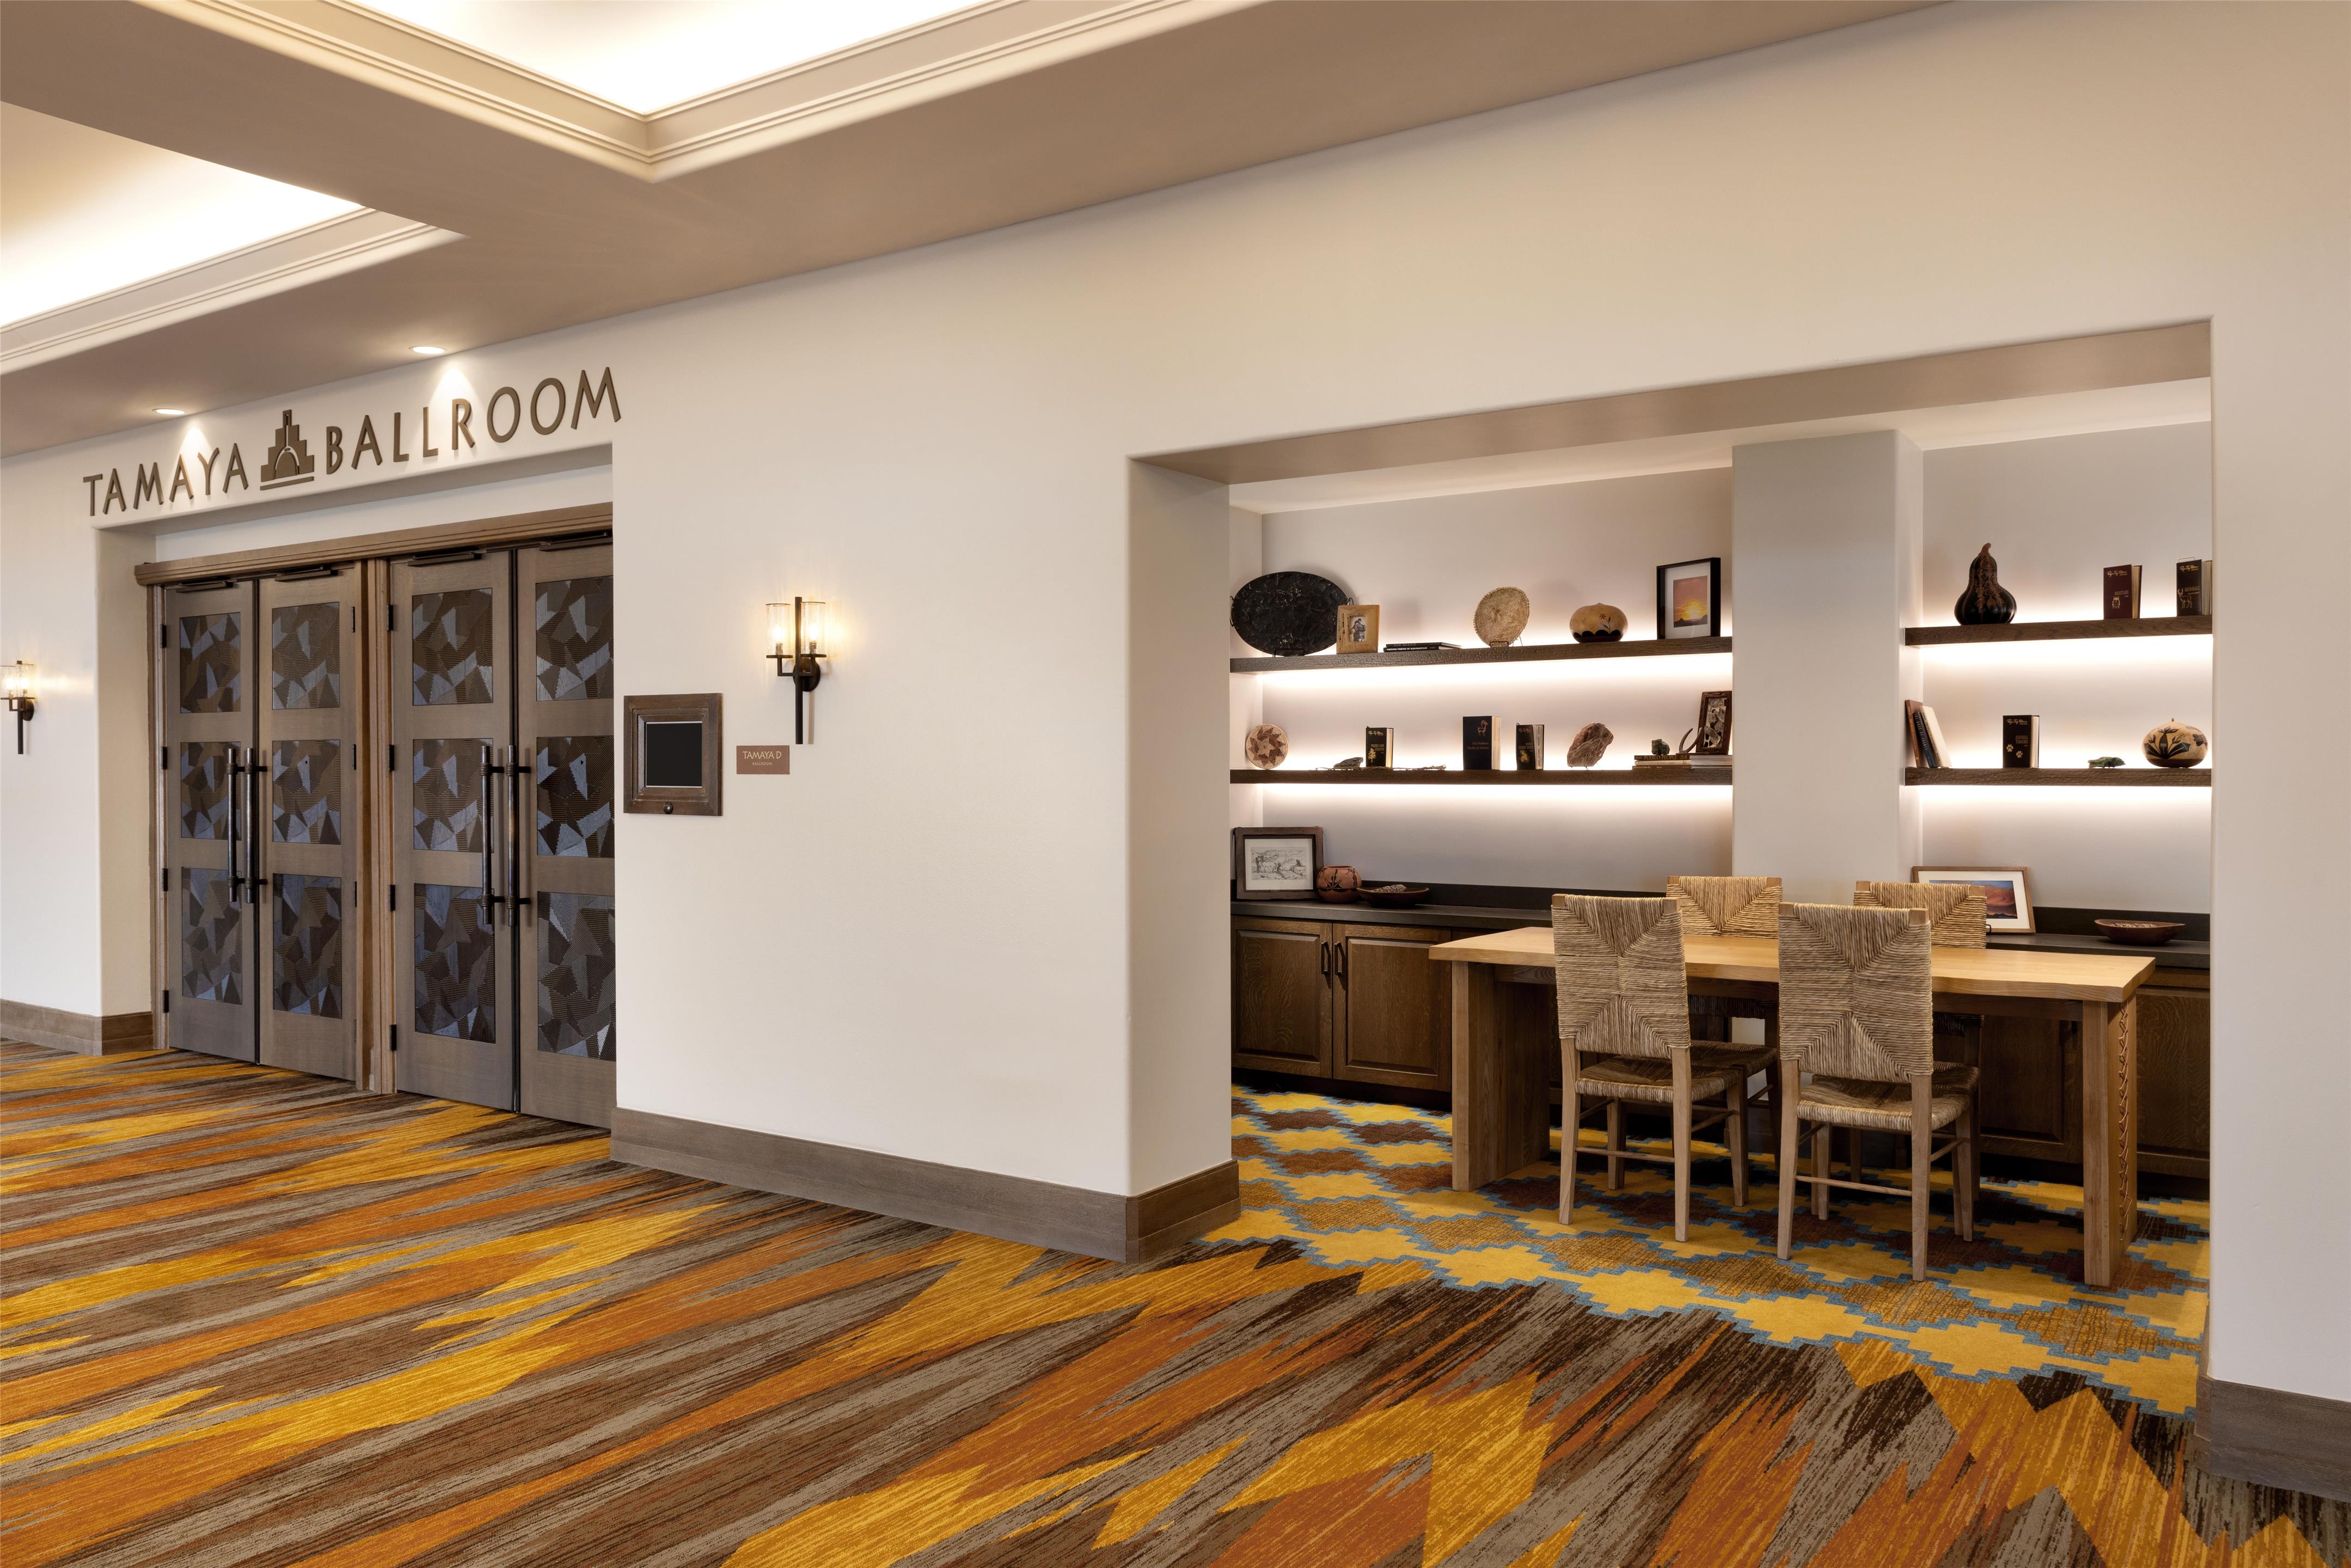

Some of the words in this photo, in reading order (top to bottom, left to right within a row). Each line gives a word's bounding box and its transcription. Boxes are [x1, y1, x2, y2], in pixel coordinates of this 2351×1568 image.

[83, 442, 248, 517] TAMAYA
[326, 366, 621, 475] BALLROOM
[742, 751, 774, 759] TAMAYA
[776, 751, 782, 759] D
